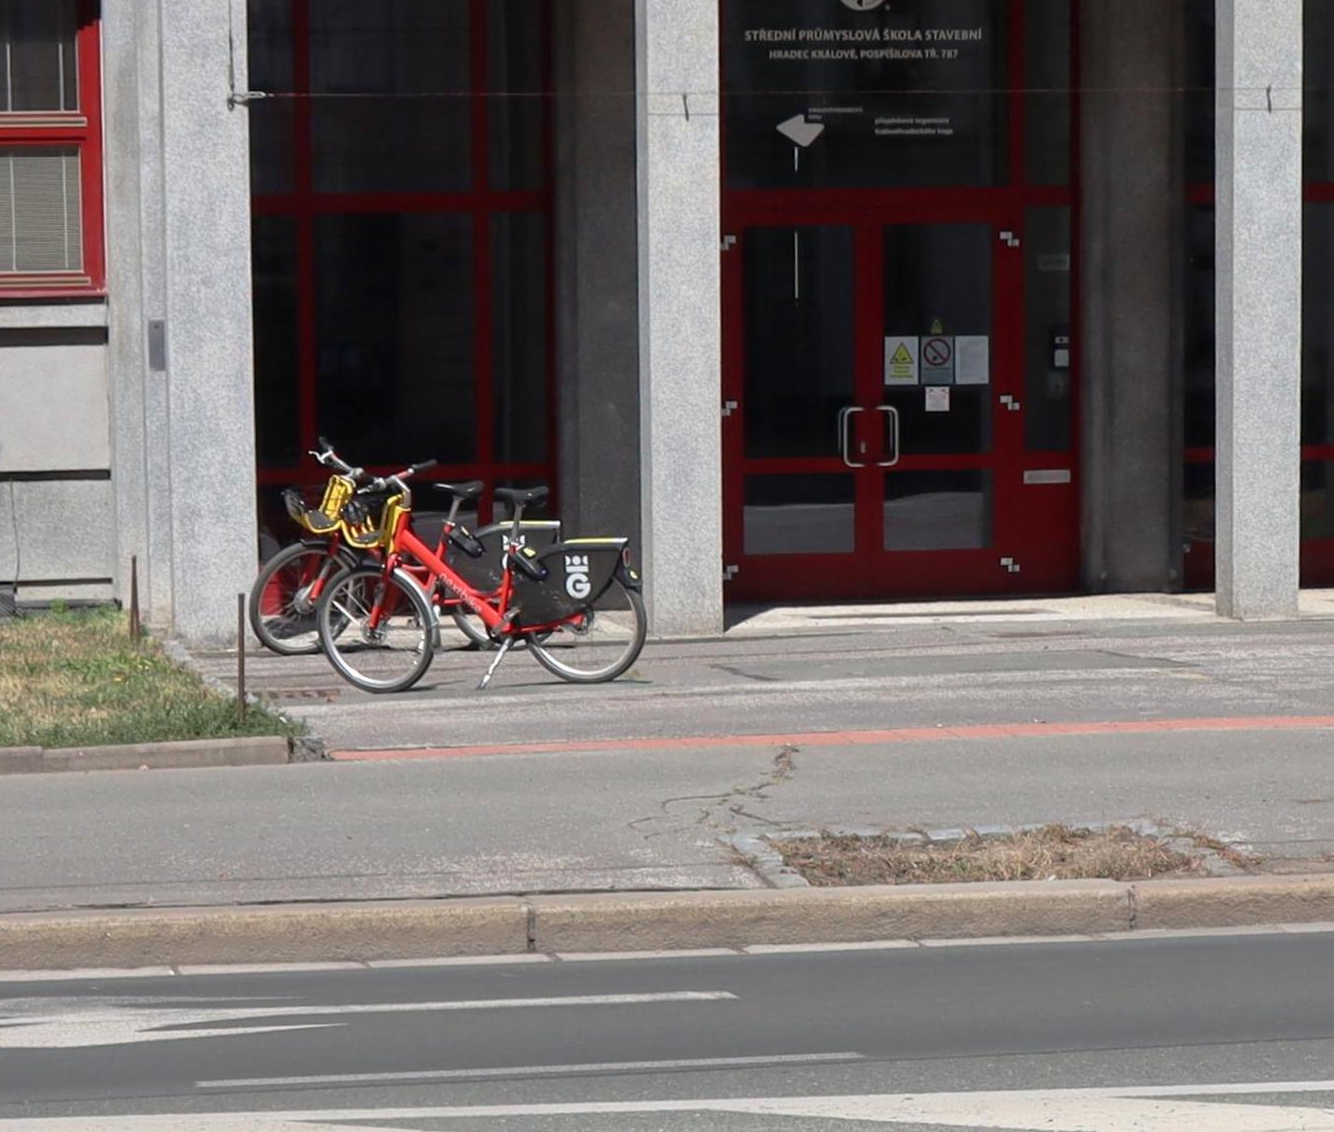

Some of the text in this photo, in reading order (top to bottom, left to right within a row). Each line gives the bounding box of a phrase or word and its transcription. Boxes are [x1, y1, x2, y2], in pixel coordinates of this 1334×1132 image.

[744, 27, 983, 42] STŘEDNÍ PRŮMYSLOVÁ ŠKOLA STAVEBNÍ
